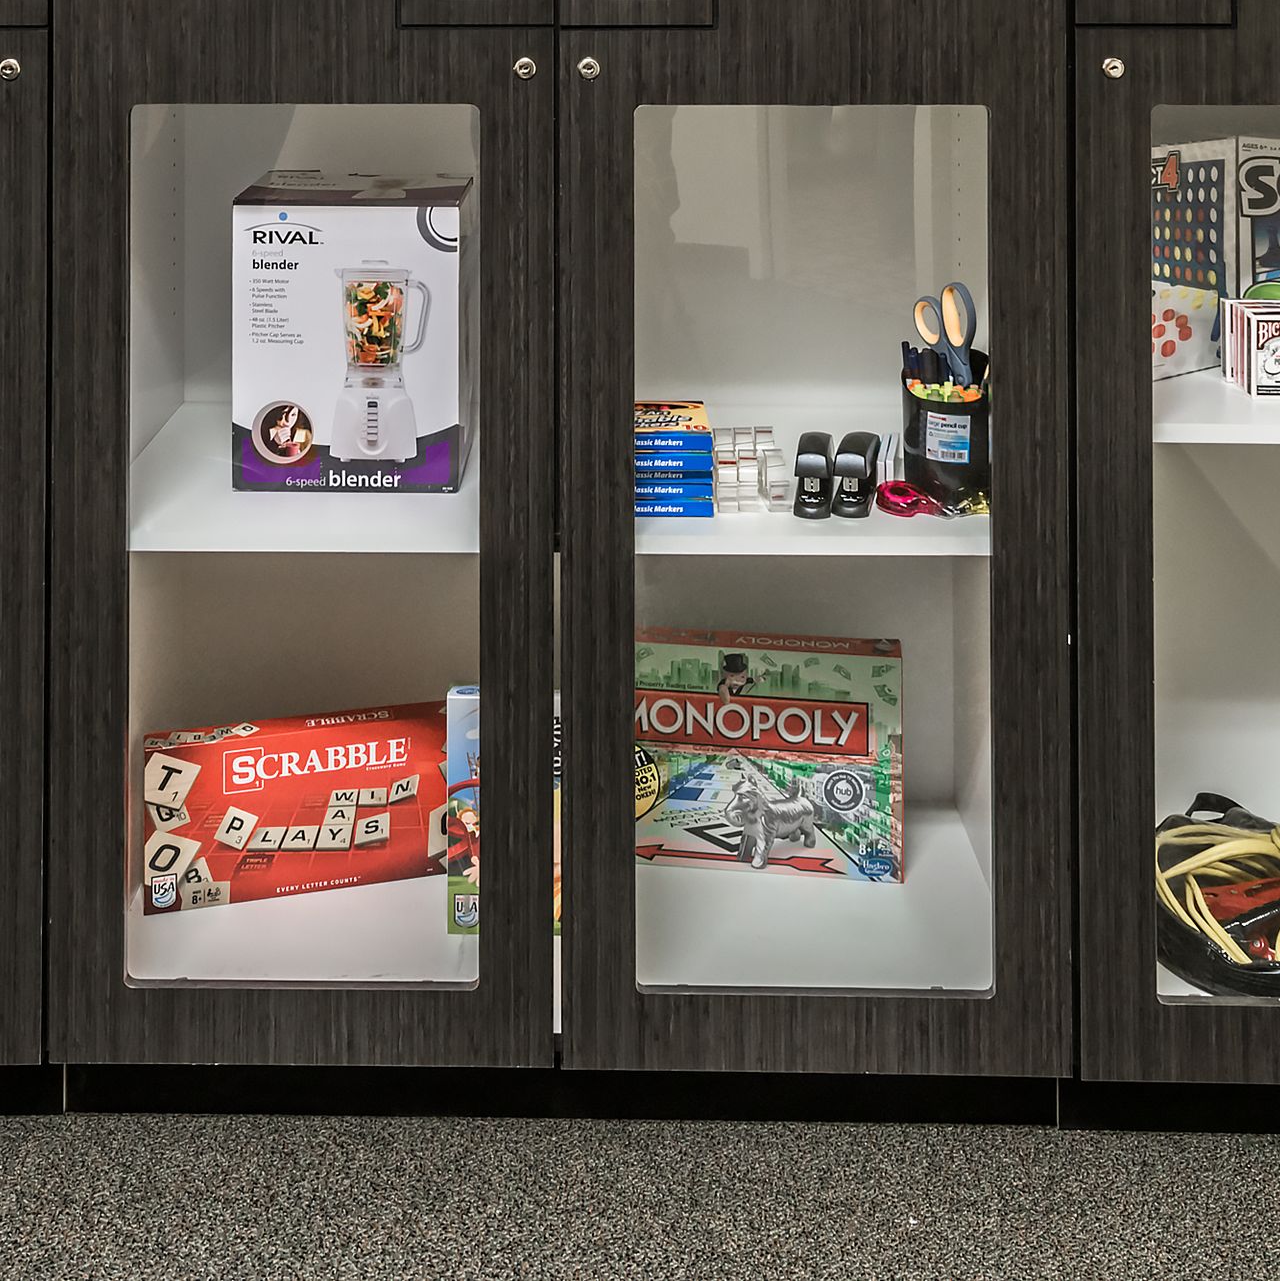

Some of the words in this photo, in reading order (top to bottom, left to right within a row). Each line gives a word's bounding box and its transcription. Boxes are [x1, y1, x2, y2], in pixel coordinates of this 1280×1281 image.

[1161, 154, 1178, 189] 4
[252, 230, 320, 245] RIVAL
[252, 249, 284, 258] 6-speed
[252, 259, 299, 270] blender
[634, 438, 653, 447] lassic
[653, 438, 683, 447] Markers
[634, 459, 653, 467] lassic
[653, 459, 683, 467] Markers
[286, 476, 326, 489] 6-speed
[329, 470, 401, 488] blender
[634, 471, 653, 479] lassic
[653, 471, 683, 479] Markers
[634, 486, 653, 494] lassic
[653, 486, 683, 494] Markers
[634, 505, 653, 513] lassic
[653, 505, 683, 513] Markers
[736, 636, 850, 649] MONOPOLY
[305, 710, 390, 727] SCRABBLE
[635, 696, 859, 747] MONOPOLY
[231, 737, 408, 785] SCRABBLE
[635, 766, 653, 777] OTED
[157, 764, 183, 792] T
[635, 790, 657, 801] OKEN!
[835, 786, 852, 797] hub
[153, 881, 175, 896] USA
[276, 883, 299, 893] EVERY
[301, 880, 328, 890] LETTER
[330, 877, 359, 887] COUNTS
[192, 895, 202, 905] 8+
[456, 901, 478, 913] UA
